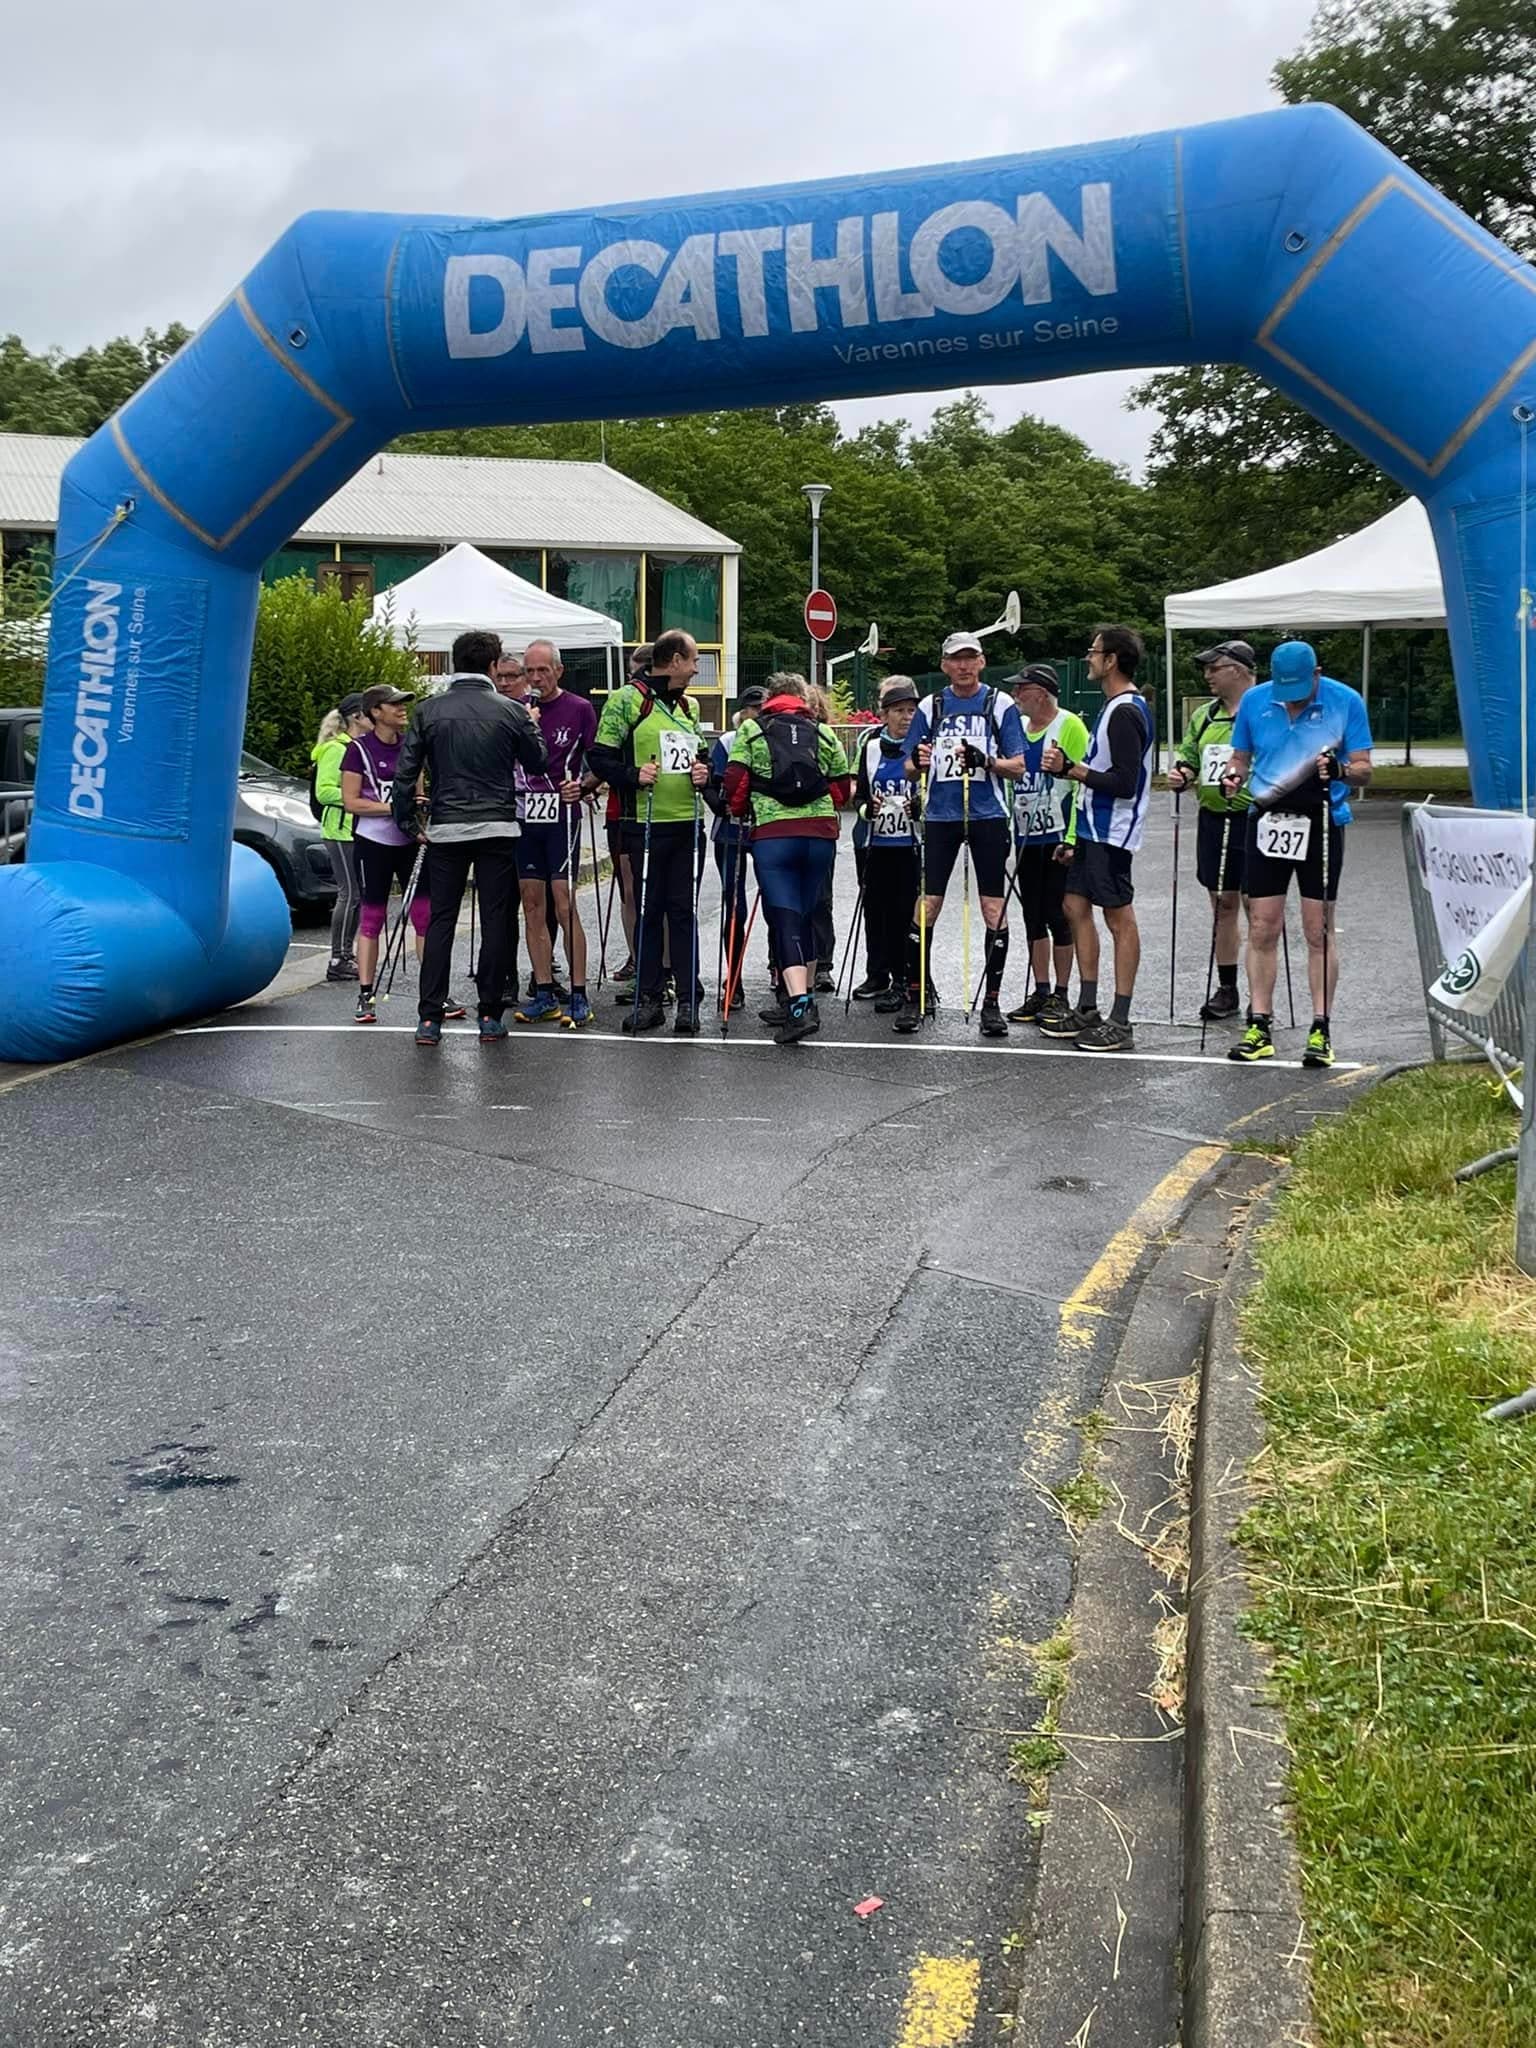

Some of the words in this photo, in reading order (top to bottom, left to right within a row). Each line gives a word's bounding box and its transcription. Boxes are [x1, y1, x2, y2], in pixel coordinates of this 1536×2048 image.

[443, 182, 1118, 359] DECATHLON
[832, 334, 969, 366] Varennes
[977, 328, 1024, 351] sur
[1033, 315, 1120, 343] Seine
[128, 587, 147, 634] Seine
[128, 638, 141, 664] sur
[68, 579, 122, 819] DECATHLON
[117, 668, 141, 743] Varennes
[670, 747, 691, 771] 23
[1207, 760, 1227, 783] 22
[526, 797, 558, 820] 226
[878, 811, 908, 835] 234
[1267, 828, 1305, 857] 237
